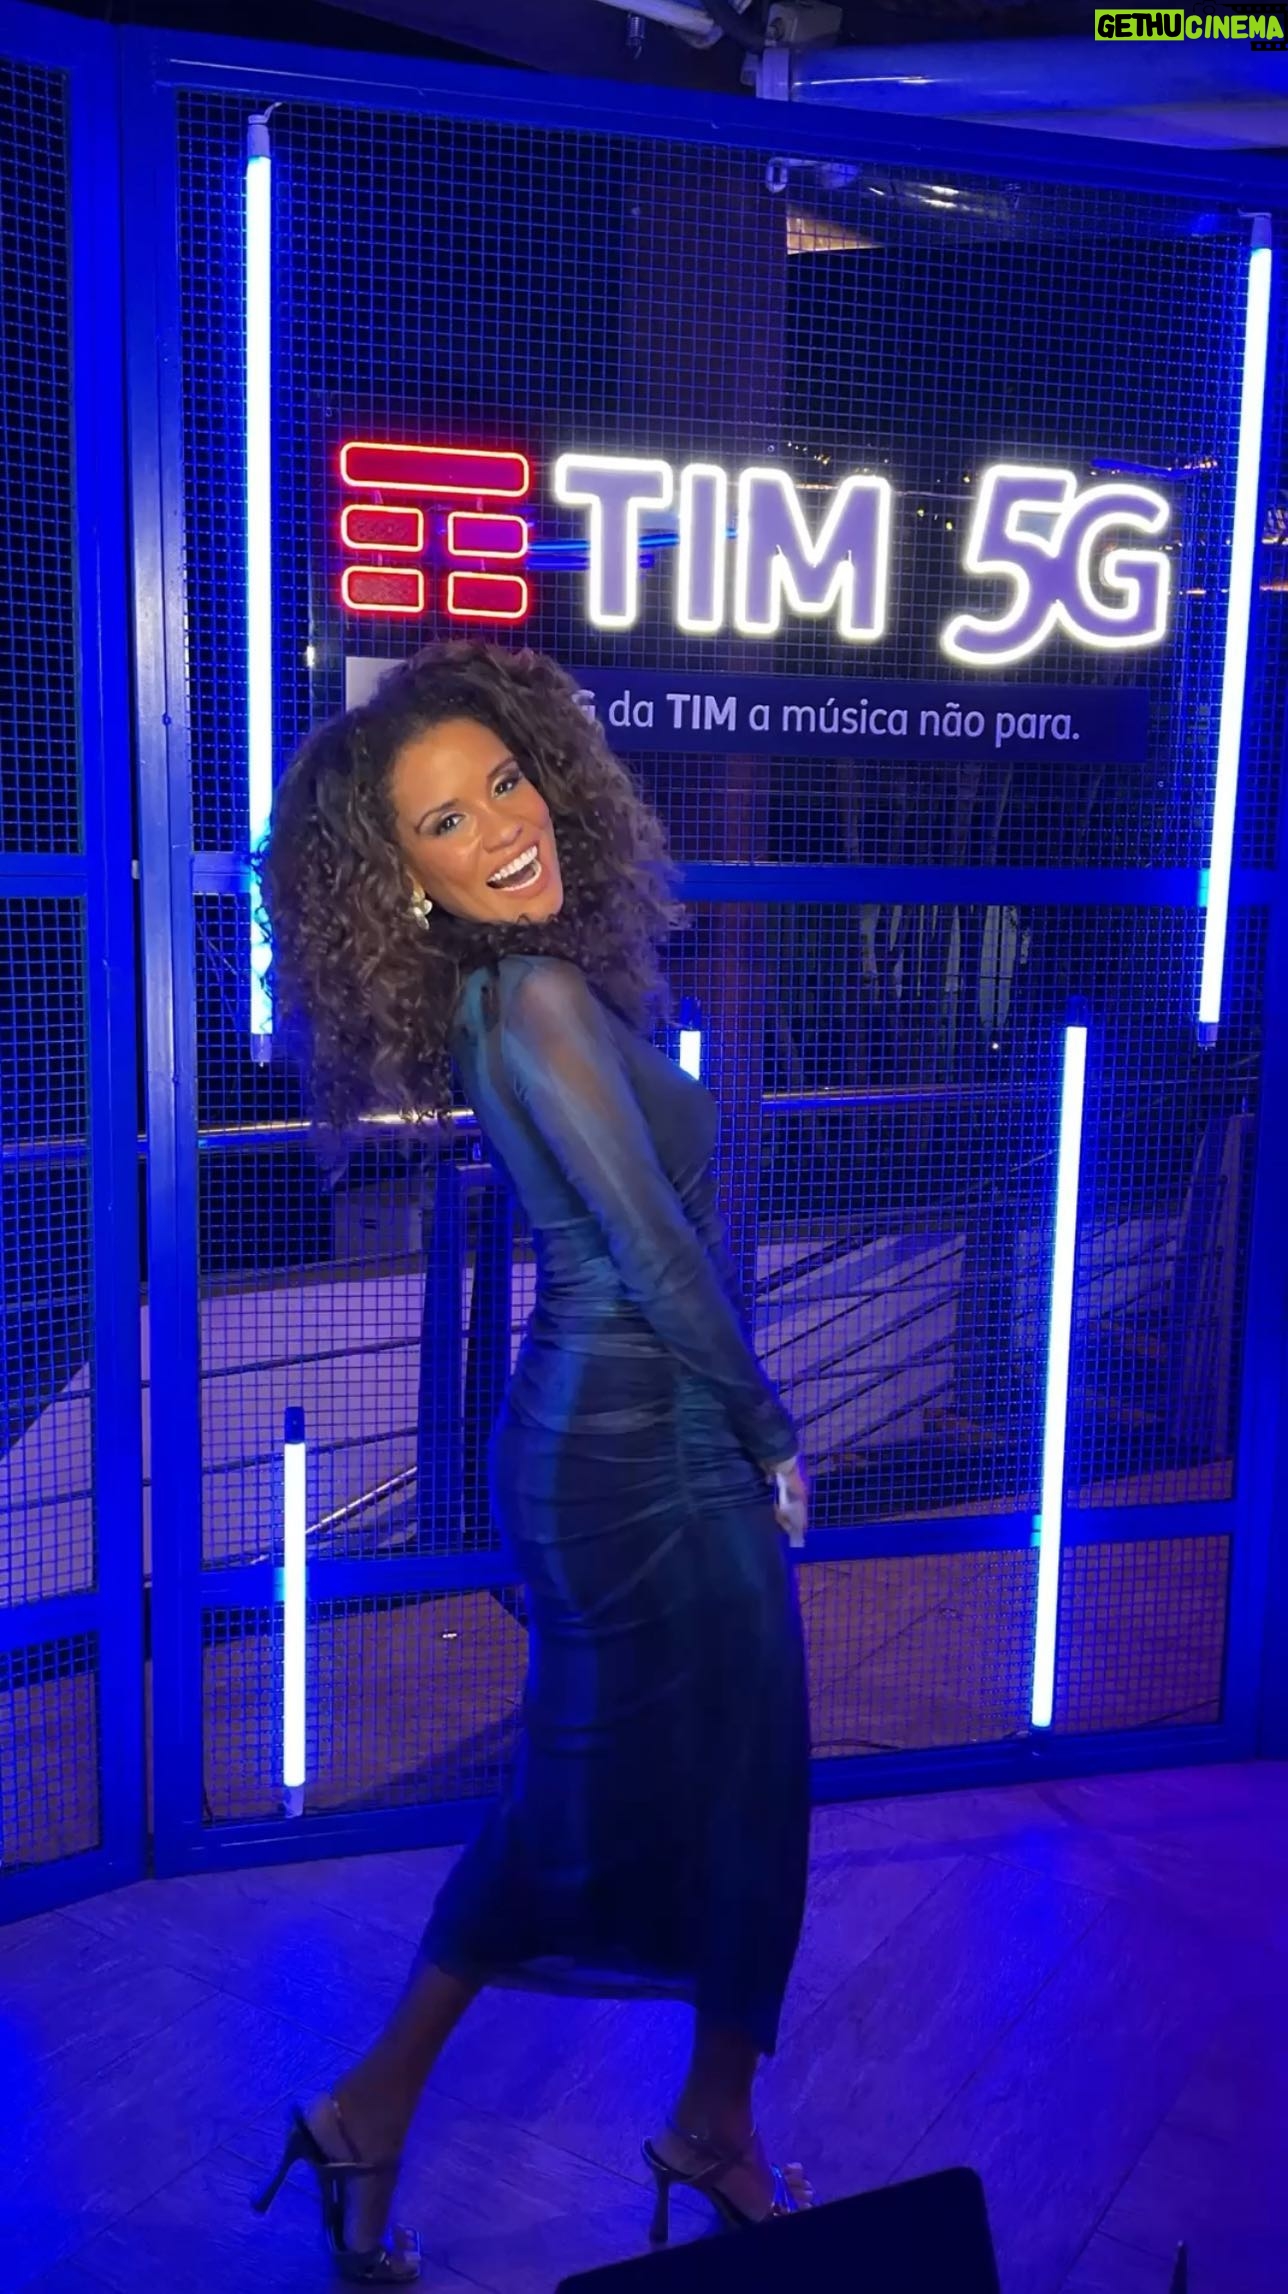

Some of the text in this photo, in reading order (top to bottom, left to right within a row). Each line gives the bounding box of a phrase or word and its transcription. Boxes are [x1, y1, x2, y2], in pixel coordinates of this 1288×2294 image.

[554, 453, 1171, 665] TIM 5G
[608, 690, 654, 728] da
[666, 693, 737, 731] TIM
[749, 704, 770, 731] a
[782, 698, 908, 735] música
[920, 702, 985, 737] não
[995, 712, 1080, 748] para.
